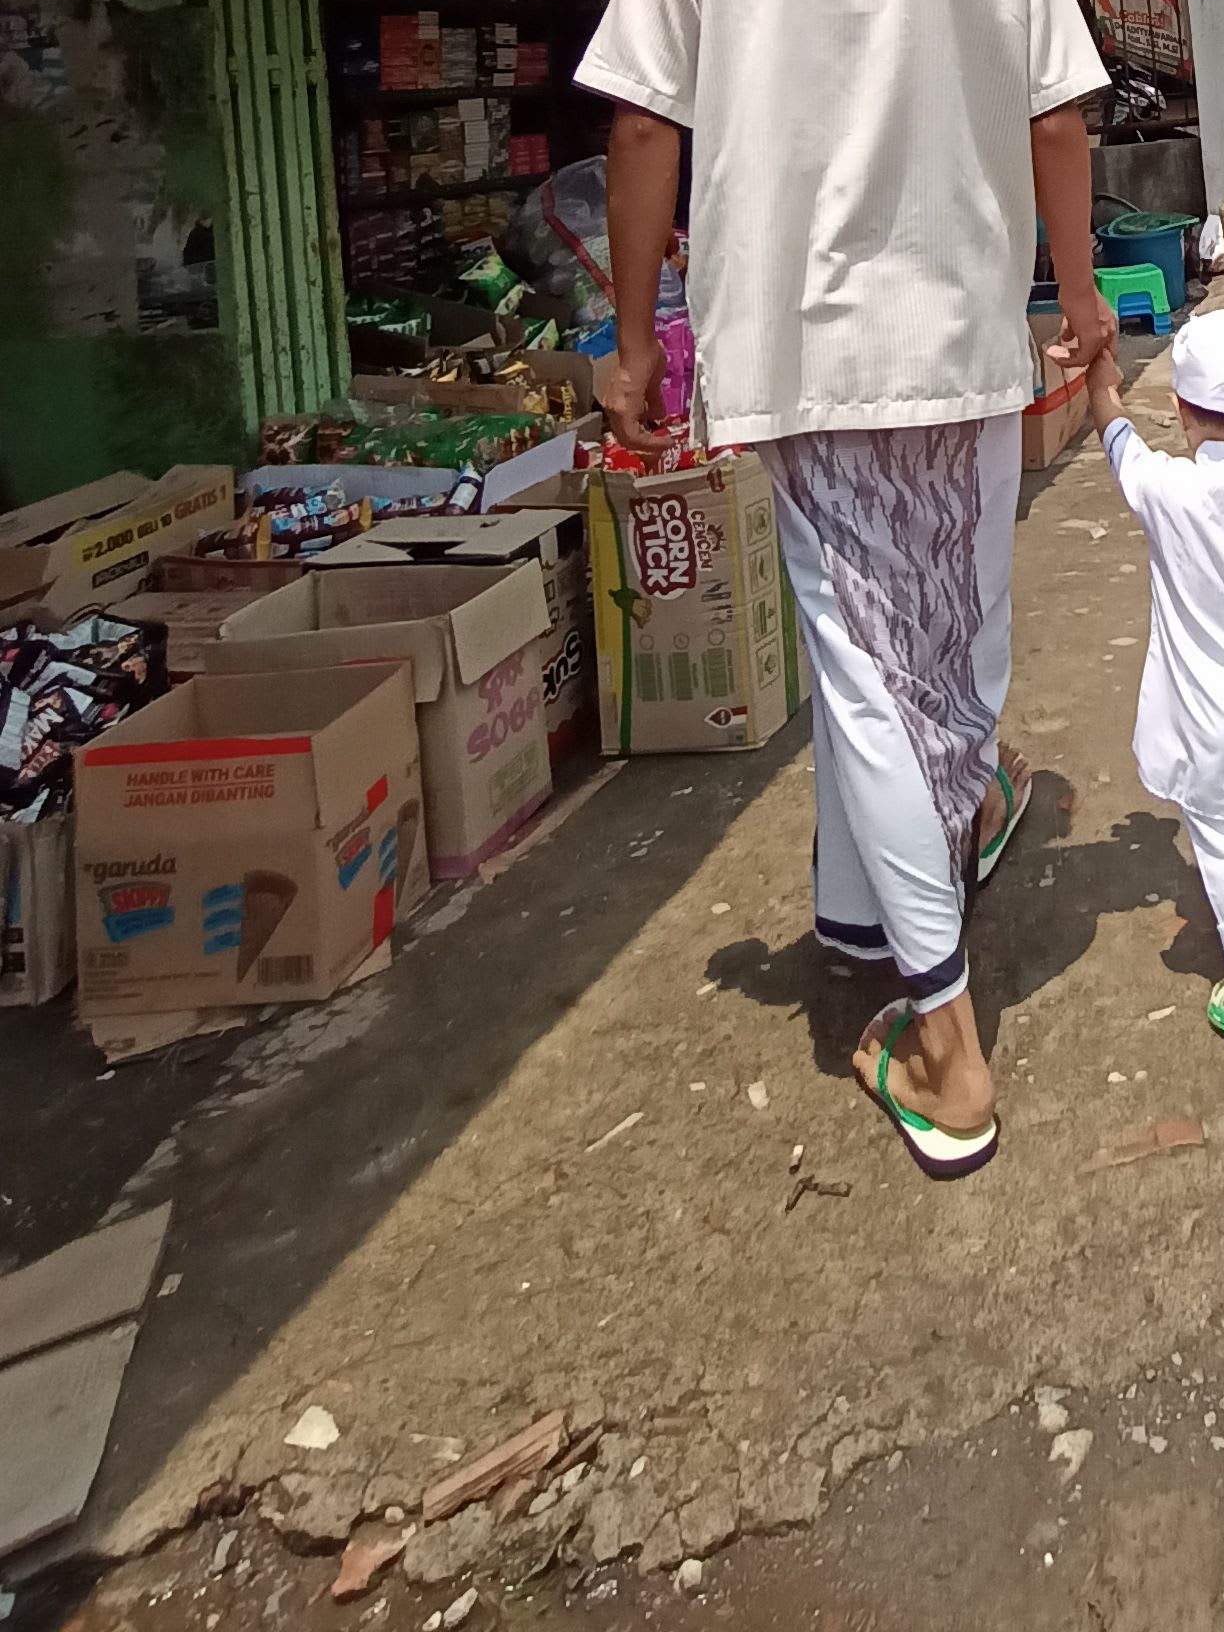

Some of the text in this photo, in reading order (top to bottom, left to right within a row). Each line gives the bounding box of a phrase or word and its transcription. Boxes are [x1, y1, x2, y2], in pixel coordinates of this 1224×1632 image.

[173, 487, 218, 520] GRATIS
[634, 501, 669, 589] STICK
[661, 498, 690, 585] CORN
[126, 763, 276, 787] HANDLE WITH CARE
[124, 784, 275, 809] JANGAN DIBANTING
[93, 852, 177, 884] garuda
